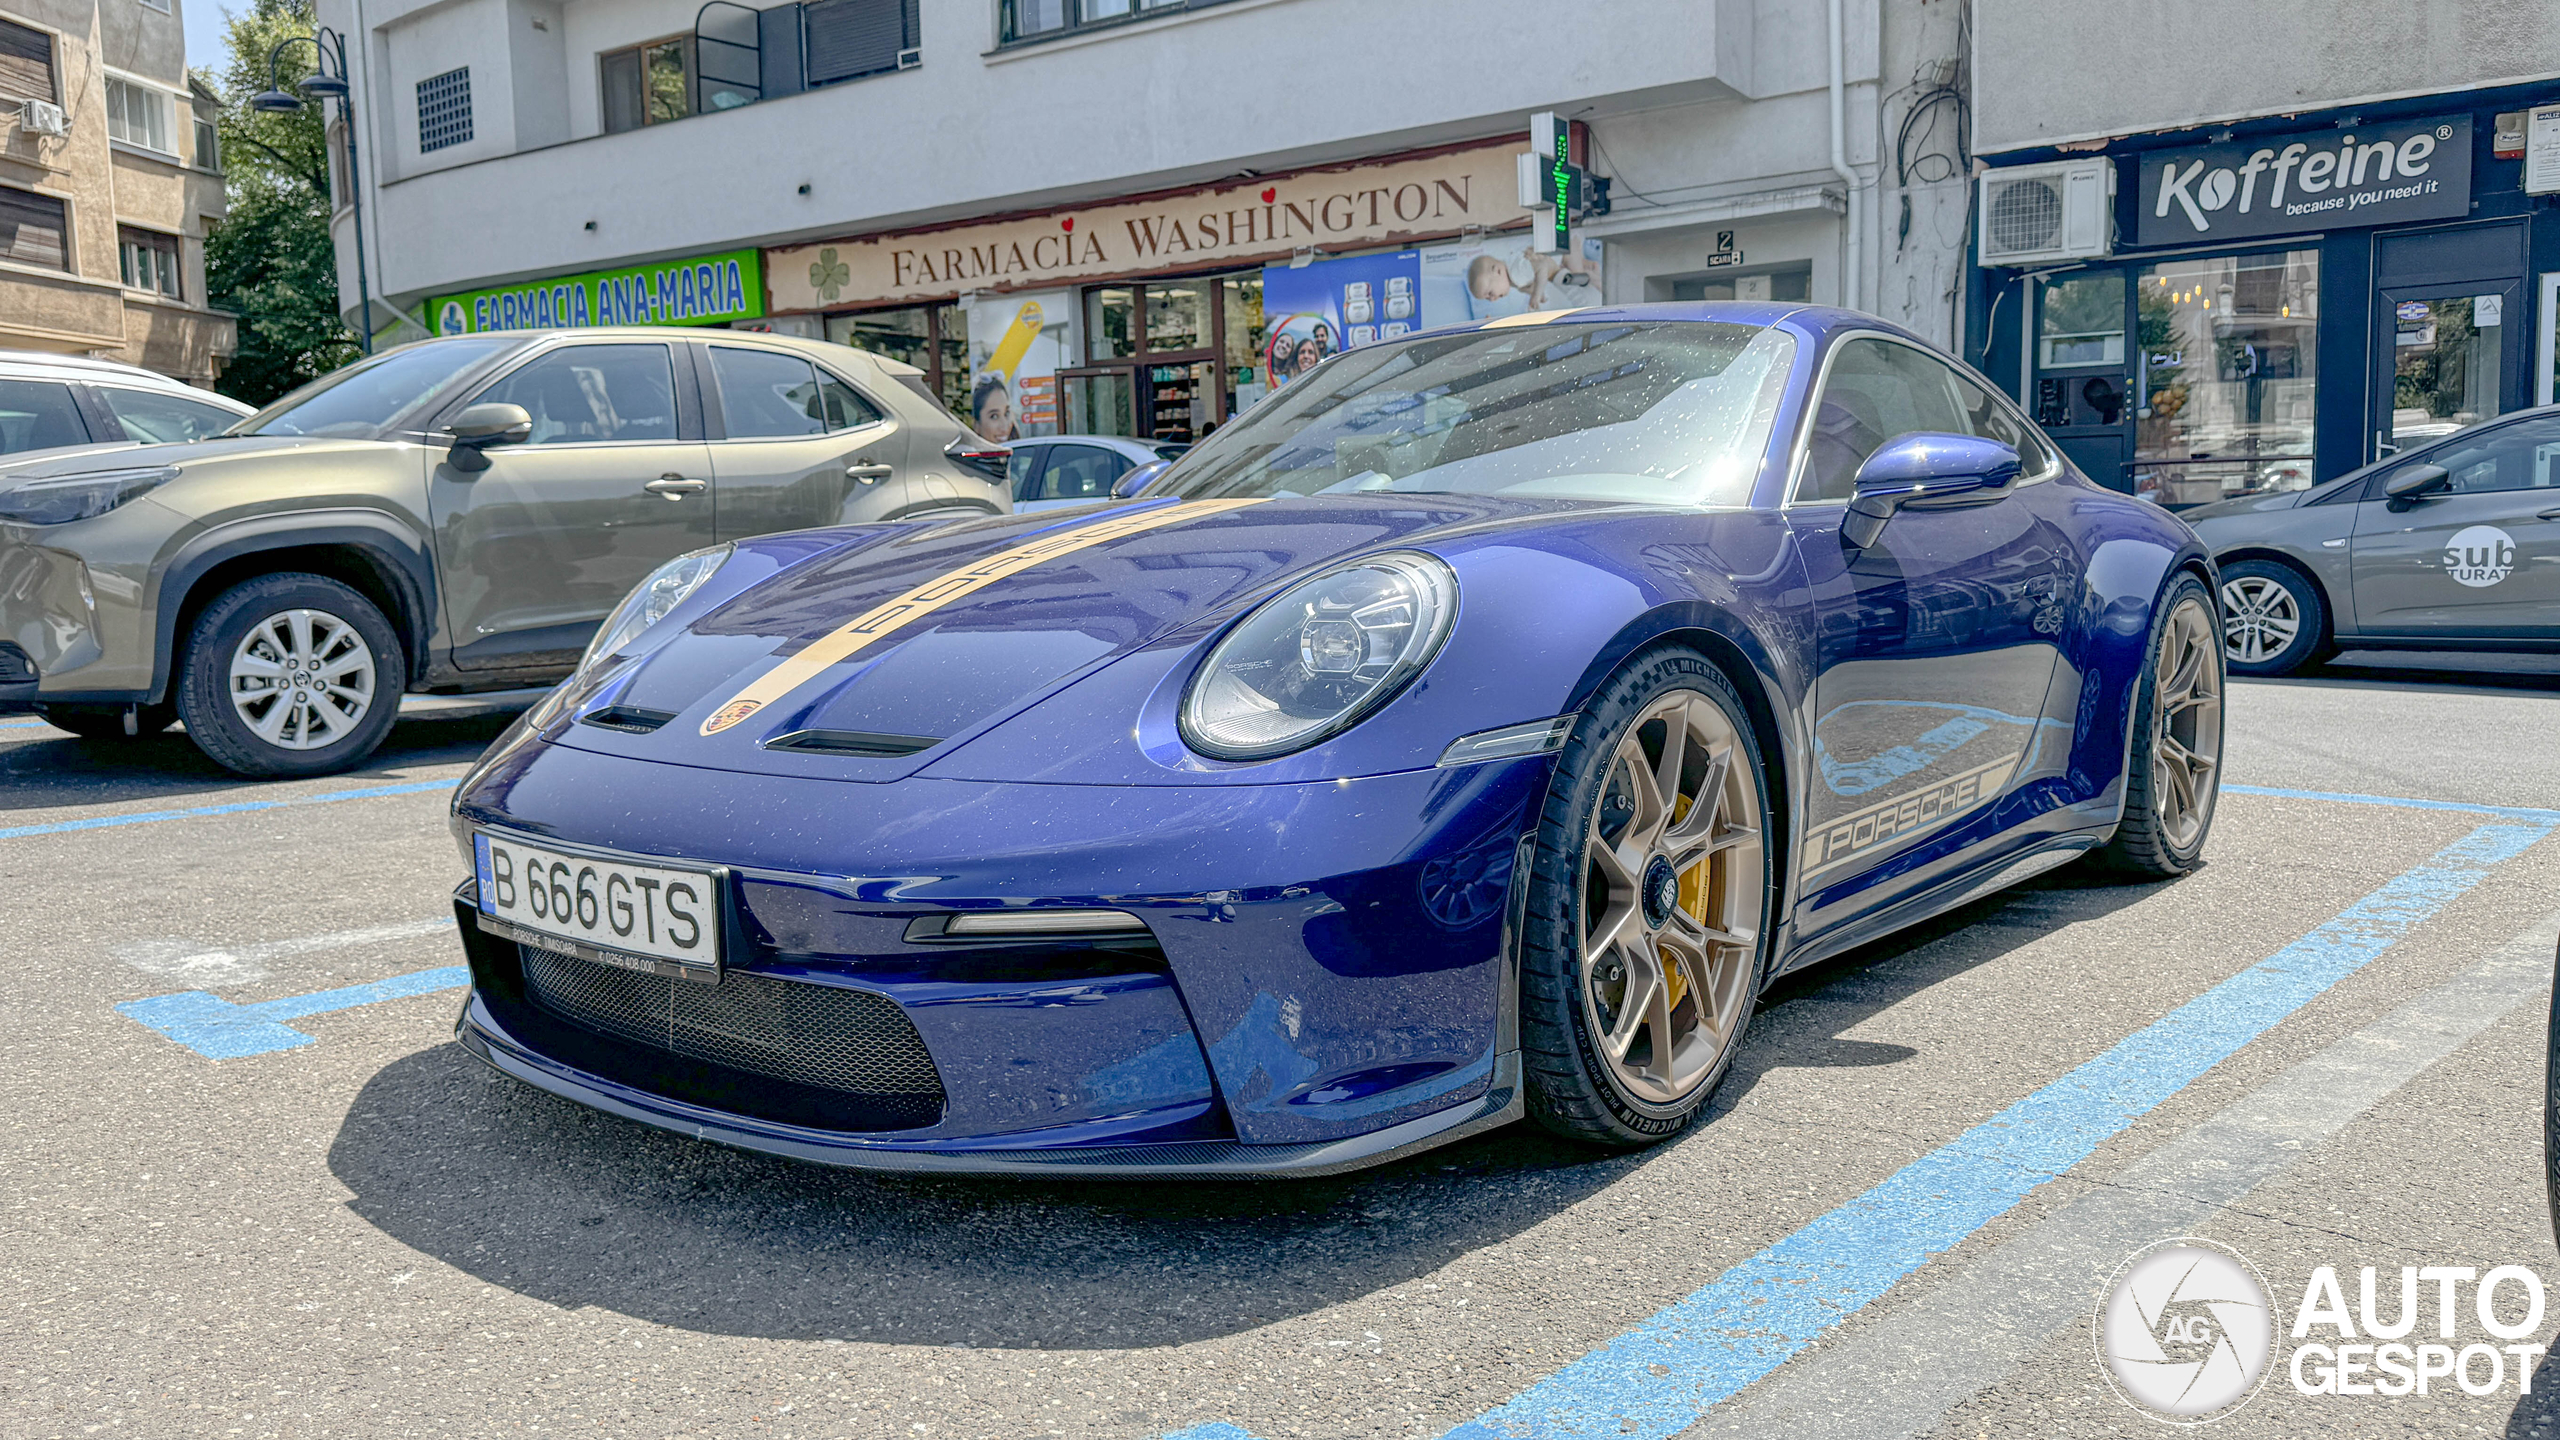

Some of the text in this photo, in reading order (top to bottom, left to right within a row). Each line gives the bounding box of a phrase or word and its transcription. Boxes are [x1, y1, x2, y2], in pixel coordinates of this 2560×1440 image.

[2286, 179, 2439, 216] because you need it
[890, 230, 1107, 288] FARMACIA
[1125, 175, 1472, 258] WASHINGTON
[1719, 232, 1732, 251] 2
[474, 259, 747, 332] FARMACIA ANA-MARIA
[847, 504, 1222, 634] PORSCHE
[2443, 540, 2516, 567] sub
[1227, 659, 1273, 670] PORSCHE
[1680, 659, 1734, 699] MICHELIN
[1827, 776, 1979, 860] PORSCHE
[482, 877, 495, 904] RO
[492, 846, 701, 949] B 666 GTS
[513, 928, 541, 947] PORSCHE
[544, 936, 578, 956] TIMISOARA
[606, 952, 624, 967] 0256
[1576, 1025, 1683, 1134] MICHELIN PILOT SPORT CUP
